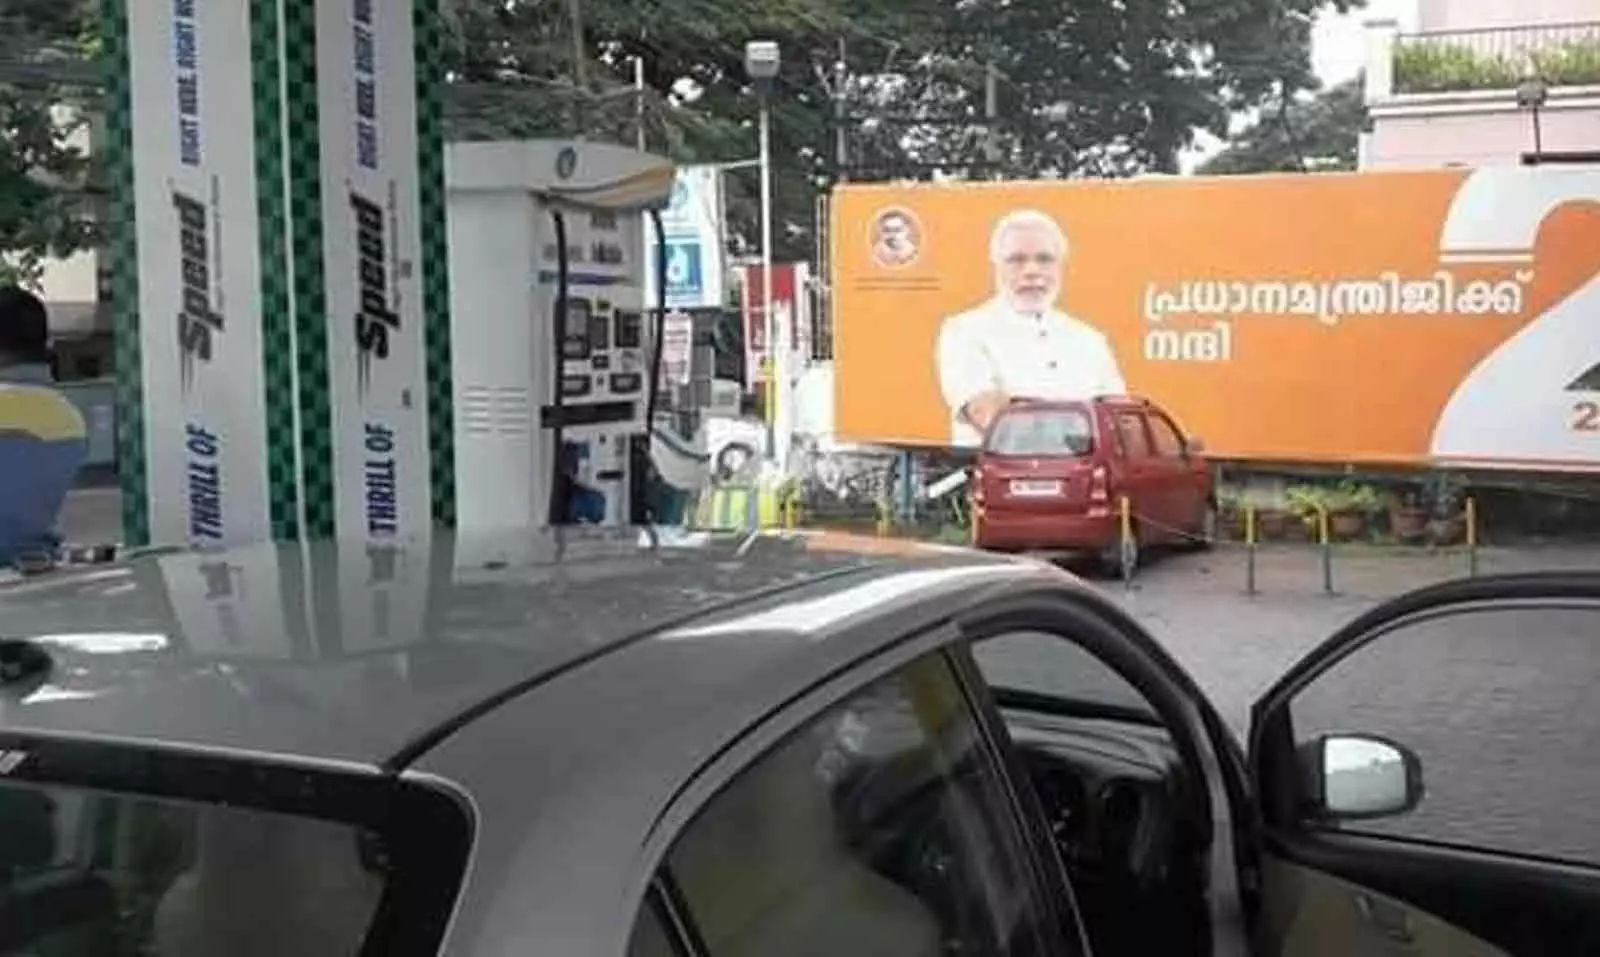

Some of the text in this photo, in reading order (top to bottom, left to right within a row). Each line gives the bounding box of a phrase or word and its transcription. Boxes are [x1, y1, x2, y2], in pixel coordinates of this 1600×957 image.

[350, 191, 401, 360] Speed
[172, 191, 226, 540] THRILL OF Speed
[364, 422, 394, 452] OF
[365, 458, 398, 533] THRILL
